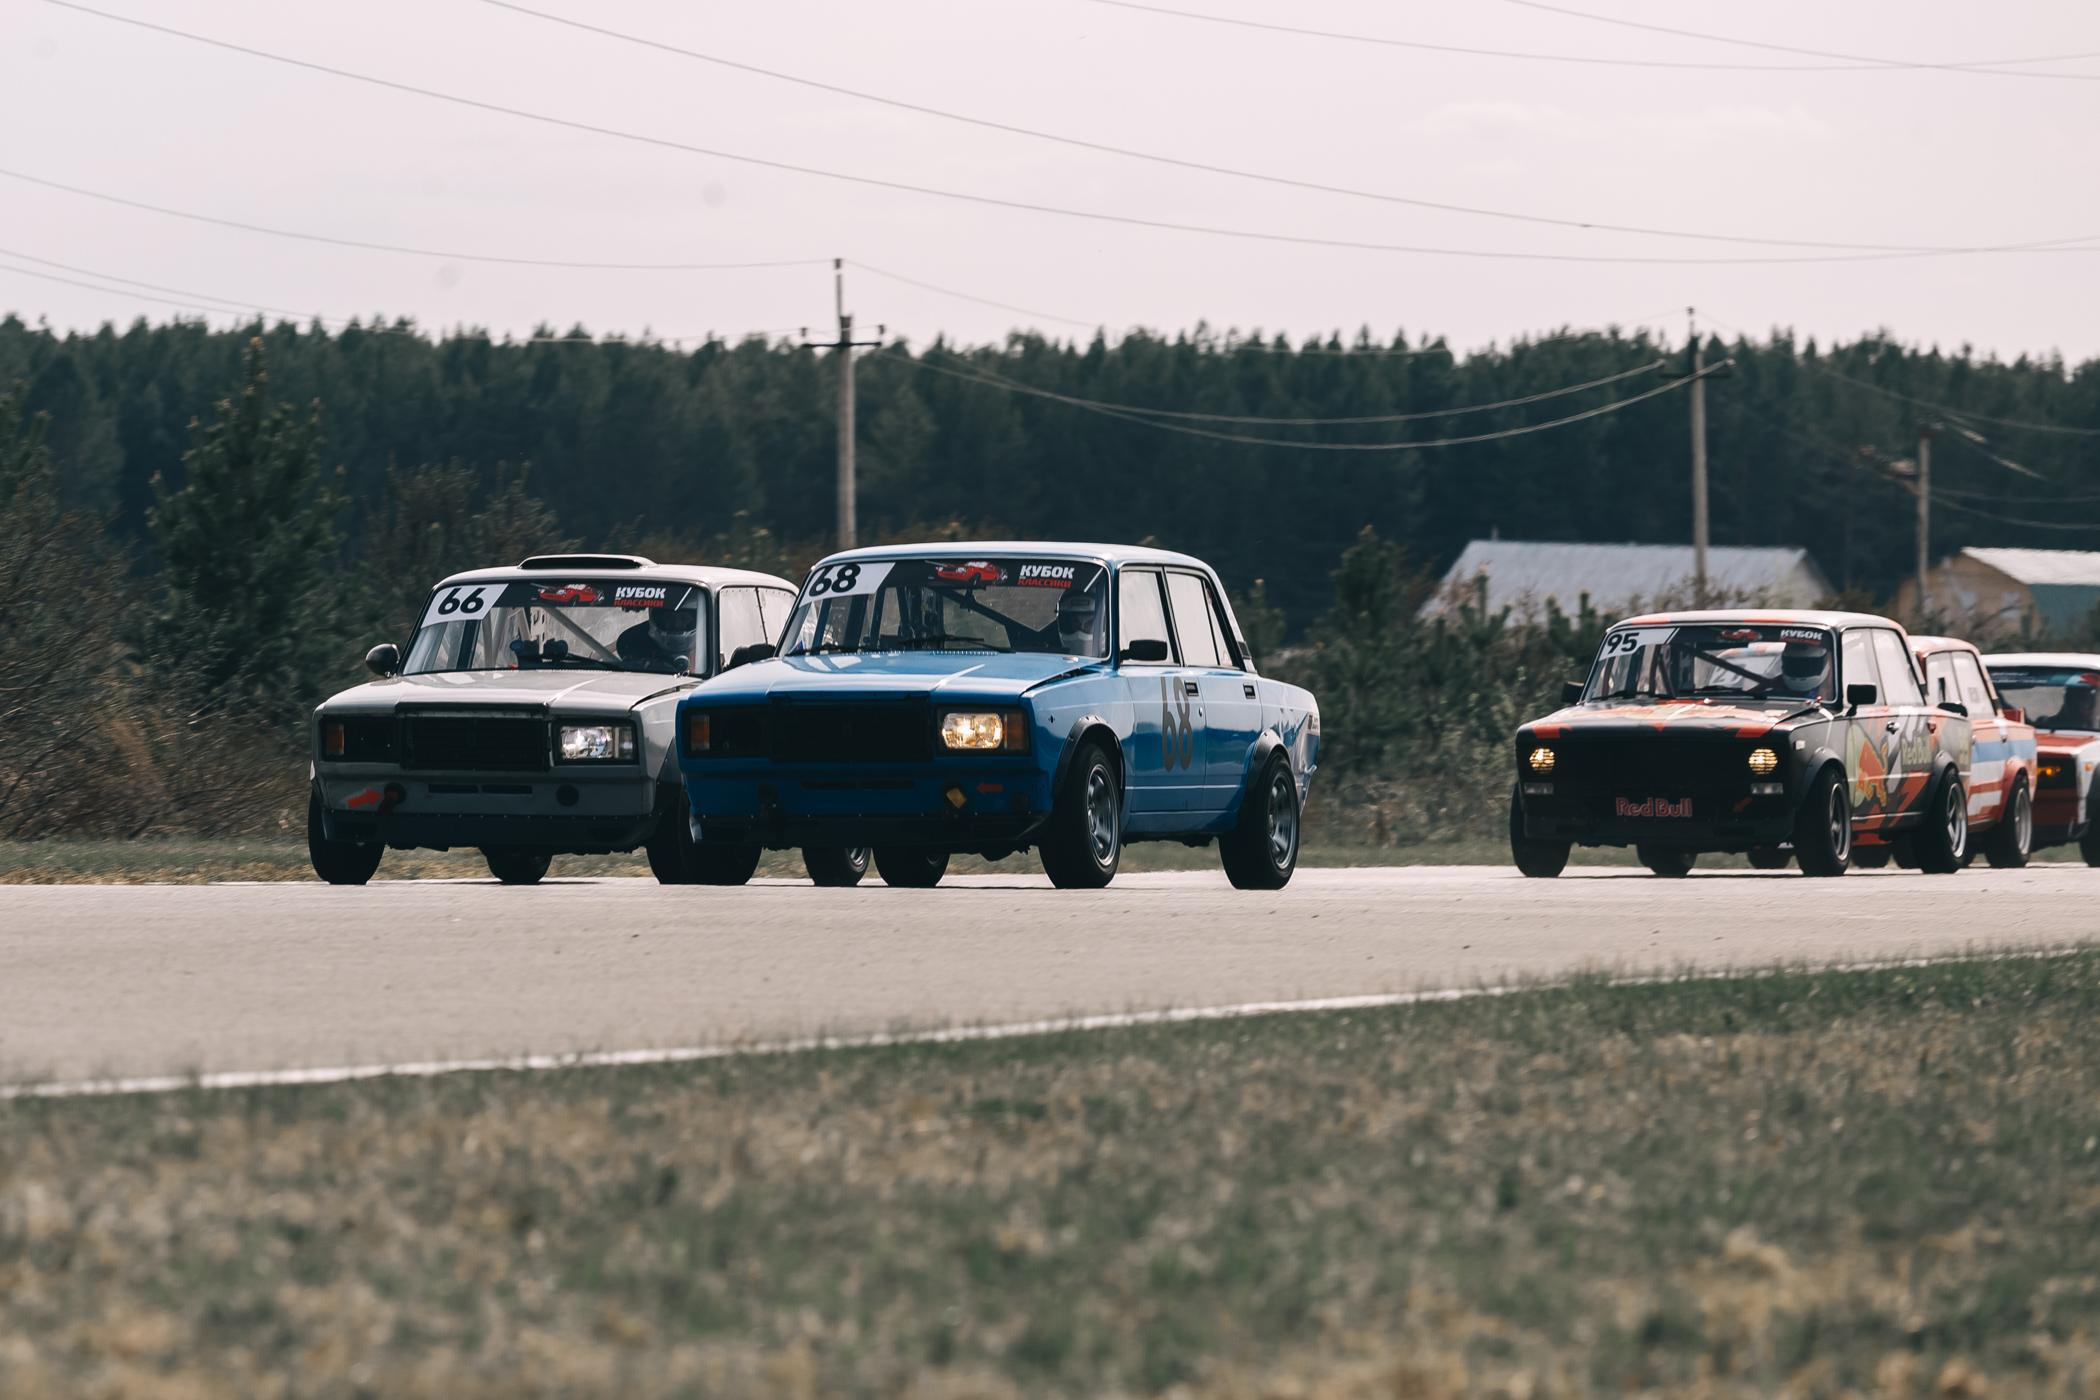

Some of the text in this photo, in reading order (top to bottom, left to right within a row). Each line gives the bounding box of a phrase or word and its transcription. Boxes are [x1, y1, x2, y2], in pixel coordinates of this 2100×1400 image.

[809, 562, 861, 597] 68
[1020, 565, 1074, 579] КУБОК
[438, 587, 486, 615] 66
[615, 587, 666, 599] КУБОК
[1607, 632, 1640, 654] 95
[1780, 629, 1823, 640] КУБОК
[1161, 676, 1193, 772] 68
[1616, 797, 1693, 817] Red Bull
